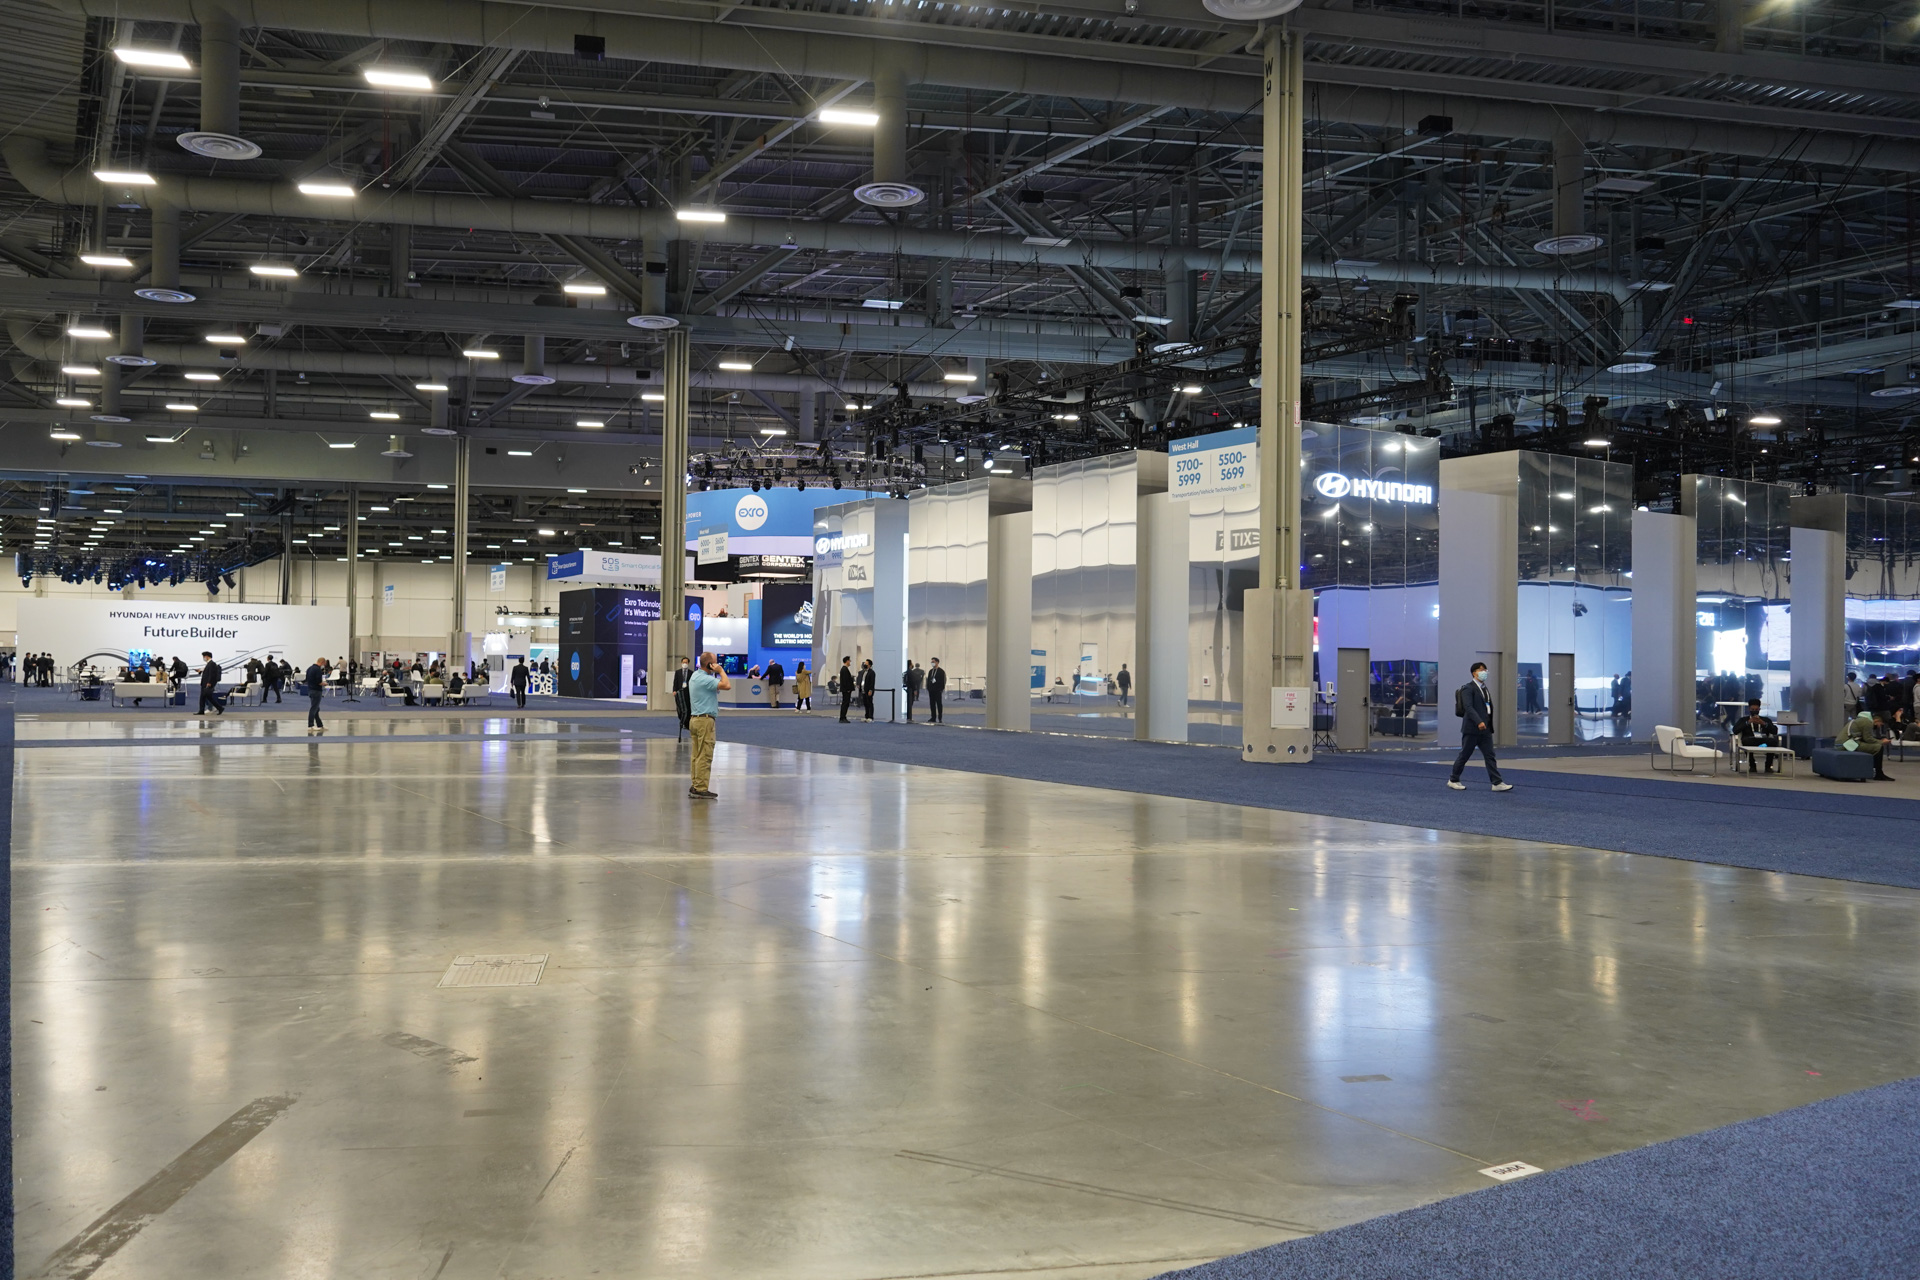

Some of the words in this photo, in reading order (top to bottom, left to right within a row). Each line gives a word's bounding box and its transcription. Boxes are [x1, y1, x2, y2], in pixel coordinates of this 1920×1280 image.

[1171, 442, 1186, 452] West
[1187, 440, 1199, 449] Hall
[1218, 451, 1247, 466] 5500-
[1176, 458, 1203, 472] 5700-
[1178, 472, 1201, 487] 5999
[1220, 466, 1244, 481] 5699
[1215, 485, 1238, 494] Technology
[1351, 478, 1432, 504] HYUNDAI
[830, 534, 868, 551] HYUNDAI
[602, 557, 620, 565] SOS
[761, 554, 805, 564] GENTEX
[624, 598, 637, 606] Exro
[109, 611, 153, 619] HYUNDAI
[155, 612, 186, 620] HEAVY
[188, 613, 239, 621] INDUSTRIES
[241, 614, 271, 622] GROUP
[633, 609, 651, 617] What's
[144, 625, 239, 639] FutureBuilder
[533, 673, 553, 685] SOS
[533, 683, 553, 695] LAB
